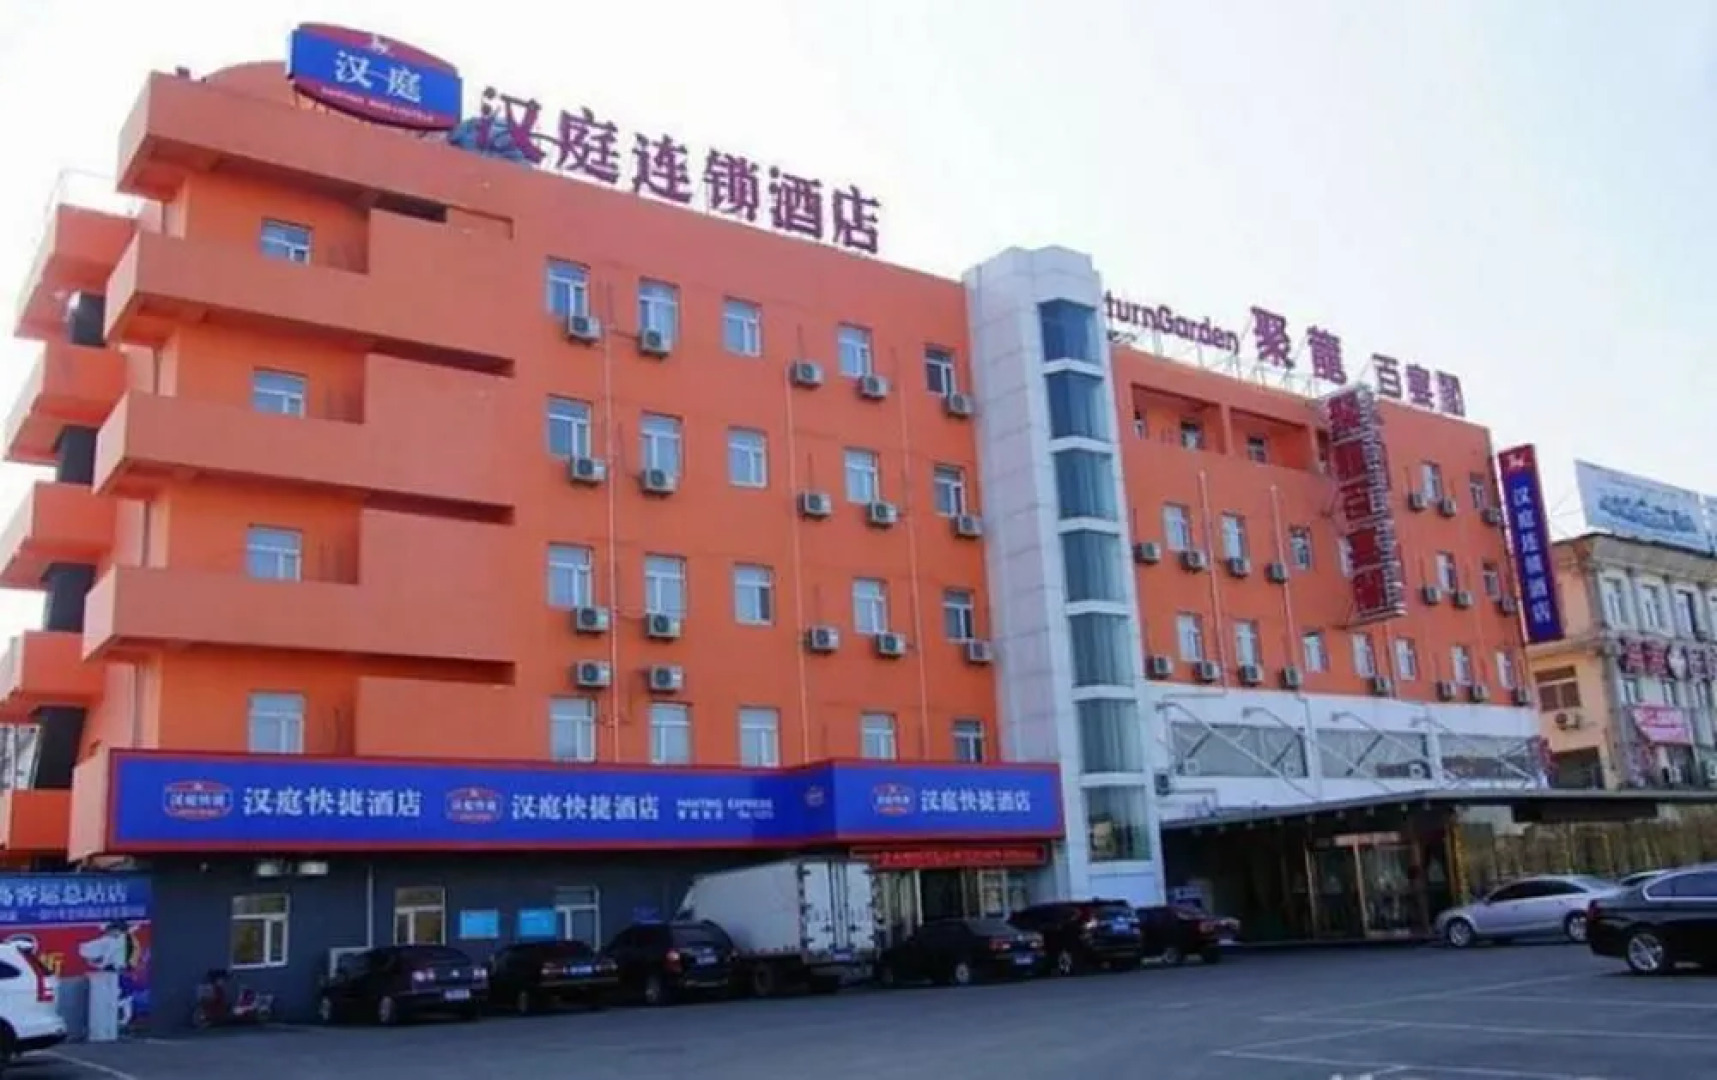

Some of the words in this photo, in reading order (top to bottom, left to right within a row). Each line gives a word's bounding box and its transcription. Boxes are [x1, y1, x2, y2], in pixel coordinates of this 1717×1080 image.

[334, 50, 422, 103] 汉庭
[479, 87, 881, 254] 汉庭连锁酒店
[243, 786, 422, 819] 汉庭快捷酒店
[511, 792, 660, 822] 汉庭快捷酒店
[920, 786, 1031, 813] 汉庭快捷酒店
